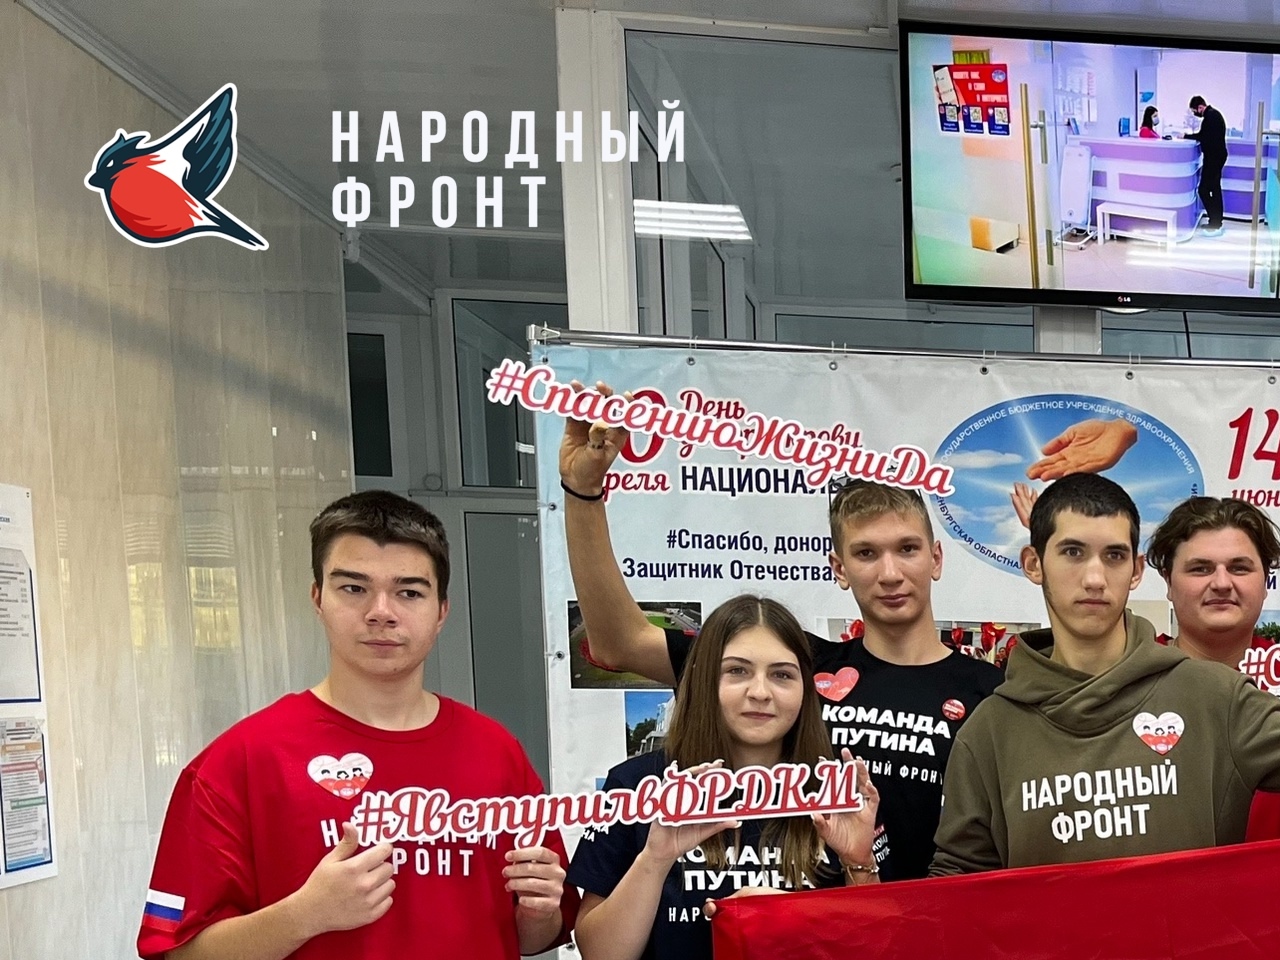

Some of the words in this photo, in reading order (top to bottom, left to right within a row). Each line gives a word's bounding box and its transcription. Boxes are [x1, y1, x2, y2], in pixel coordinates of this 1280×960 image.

[679, 390, 746, 420] День
[940, 409, 1008, 464] ОСУДАРСТВЕННОЕ
[1007, 400, 1065, 416] БЮДЖЕТНОЕ
[1066, 400, 1124, 418] УЧРЕЖДЕНИЕ
[1125, 412, 1195, 475] ЗДРАВООХРАНЕНИЯ
[602, 466, 671, 501] реля
[935, 495, 975, 545] ЕНБУРГСКАЯ
[666, 528, 769, 554] #Спасибо,
[622, 557, 723, 582] Защитник
[730, 559, 838, 584] Отечества,
[821, 703, 952, 739] КОМАНДА
[831, 727, 936, 757] ПУТИНА
[899, 765, 943, 785] ФРОН
[1021, 758, 1179, 812] НАРОДНЫЙ
[355, 762, 862, 847] #ЯвступилвФРДКМ
[1051, 803, 1152, 844] ФРОНТ
[392, 848, 474, 876] РОНТ
[684, 869, 817, 891] ПУТИНА
